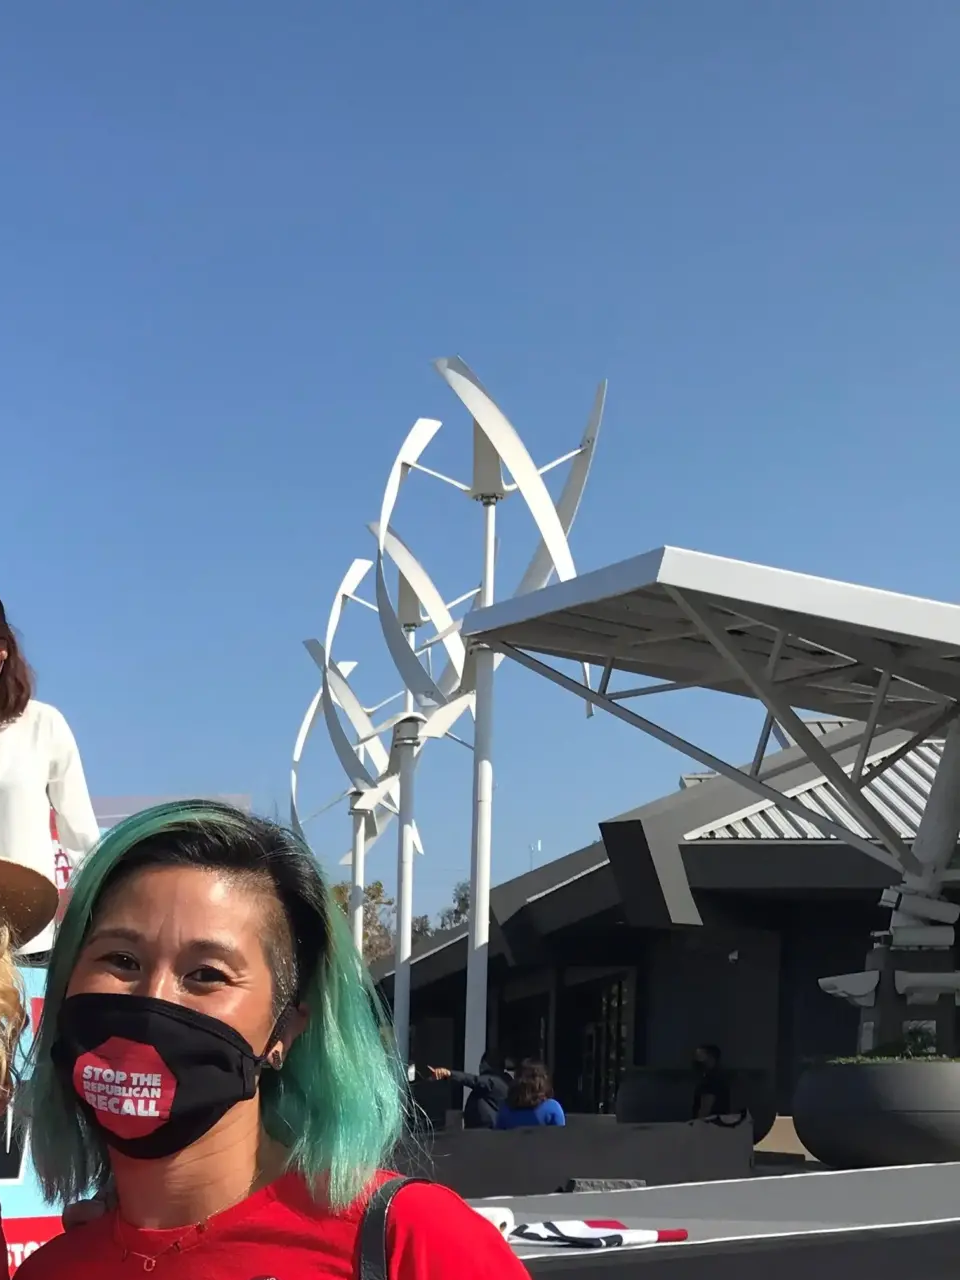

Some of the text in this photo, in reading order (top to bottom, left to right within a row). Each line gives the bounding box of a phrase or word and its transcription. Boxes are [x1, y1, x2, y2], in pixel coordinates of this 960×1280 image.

[82, 1065, 161, 1087] STOP THE
[83, 1081, 160, 1098] REPUBLICAN
[84, 1091, 160, 1117] RECALL
